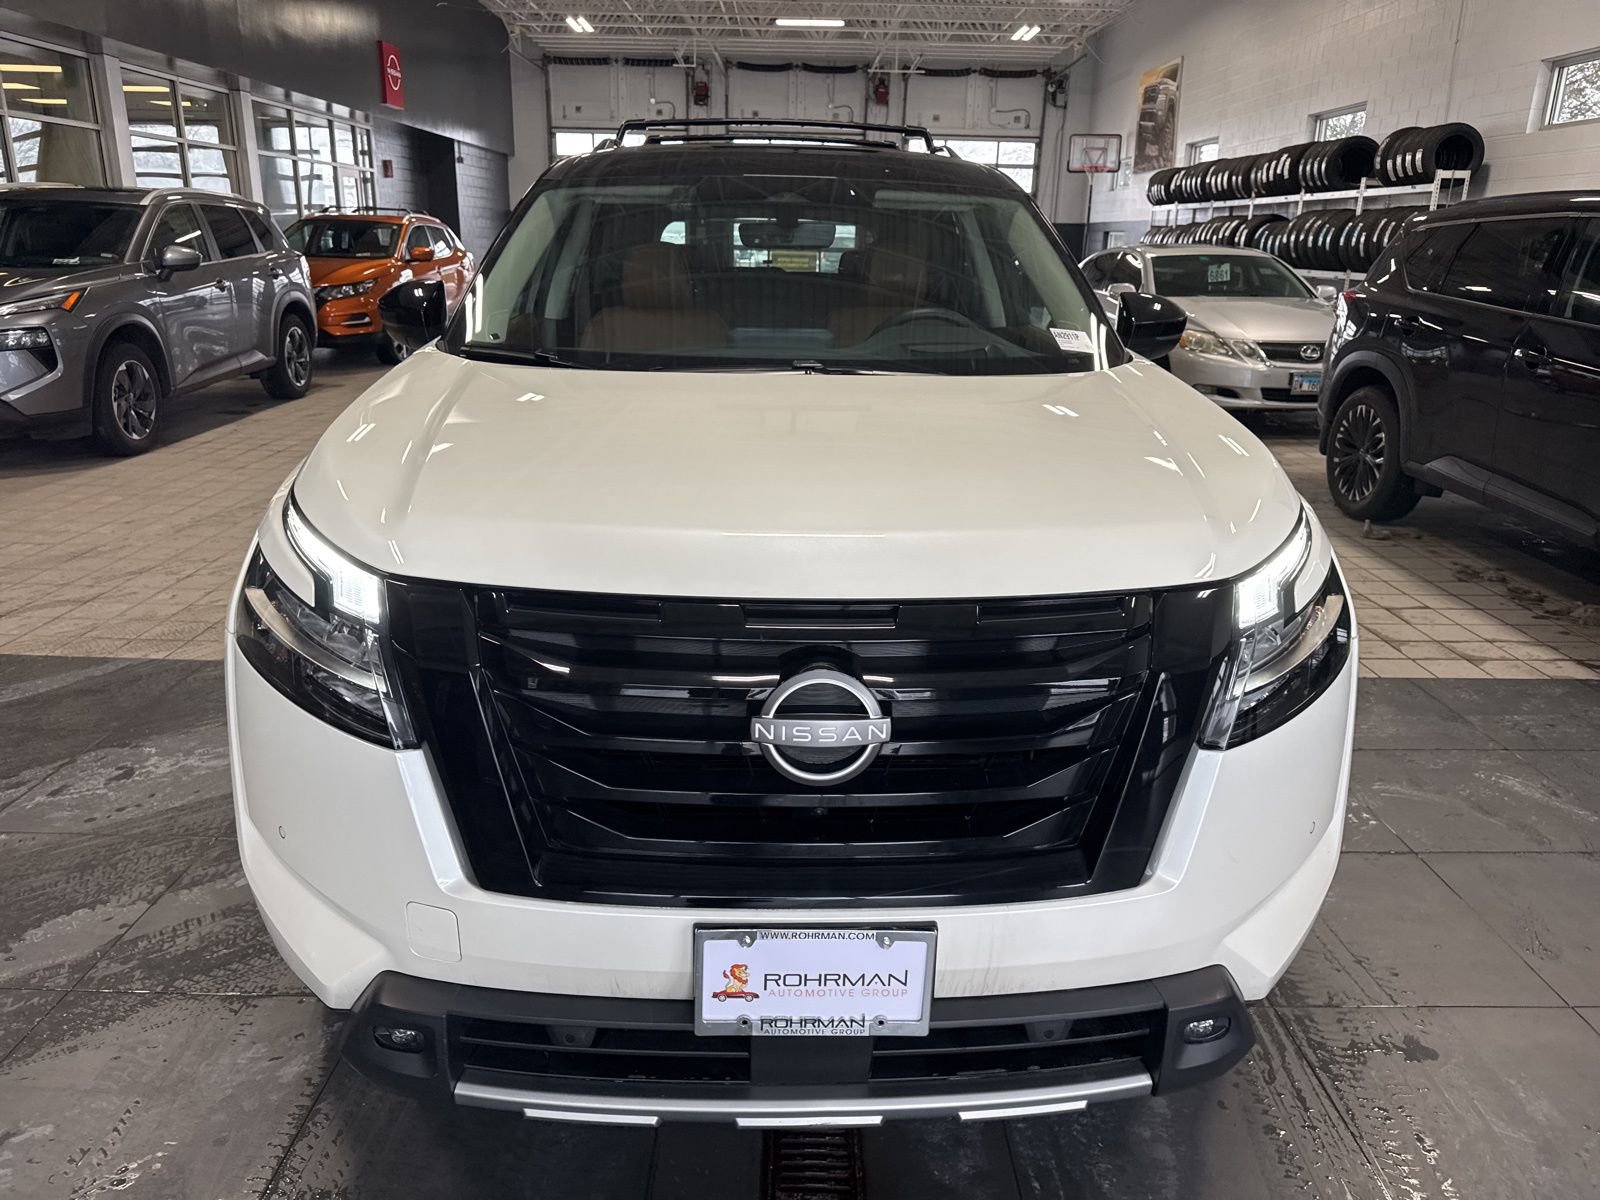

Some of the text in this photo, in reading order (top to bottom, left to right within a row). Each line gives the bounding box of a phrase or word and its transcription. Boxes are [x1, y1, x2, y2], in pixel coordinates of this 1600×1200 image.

[755, 723, 887, 742] NISSAN
[760, 931, 875, 941] WWW.ROHRMAN.COM
[763, 969, 909, 991] ROHRMAN
[768, 988, 909, 998] AUTOMOTIVE GROUP
[760, 1014, 866, 1031] ROHRMAN
